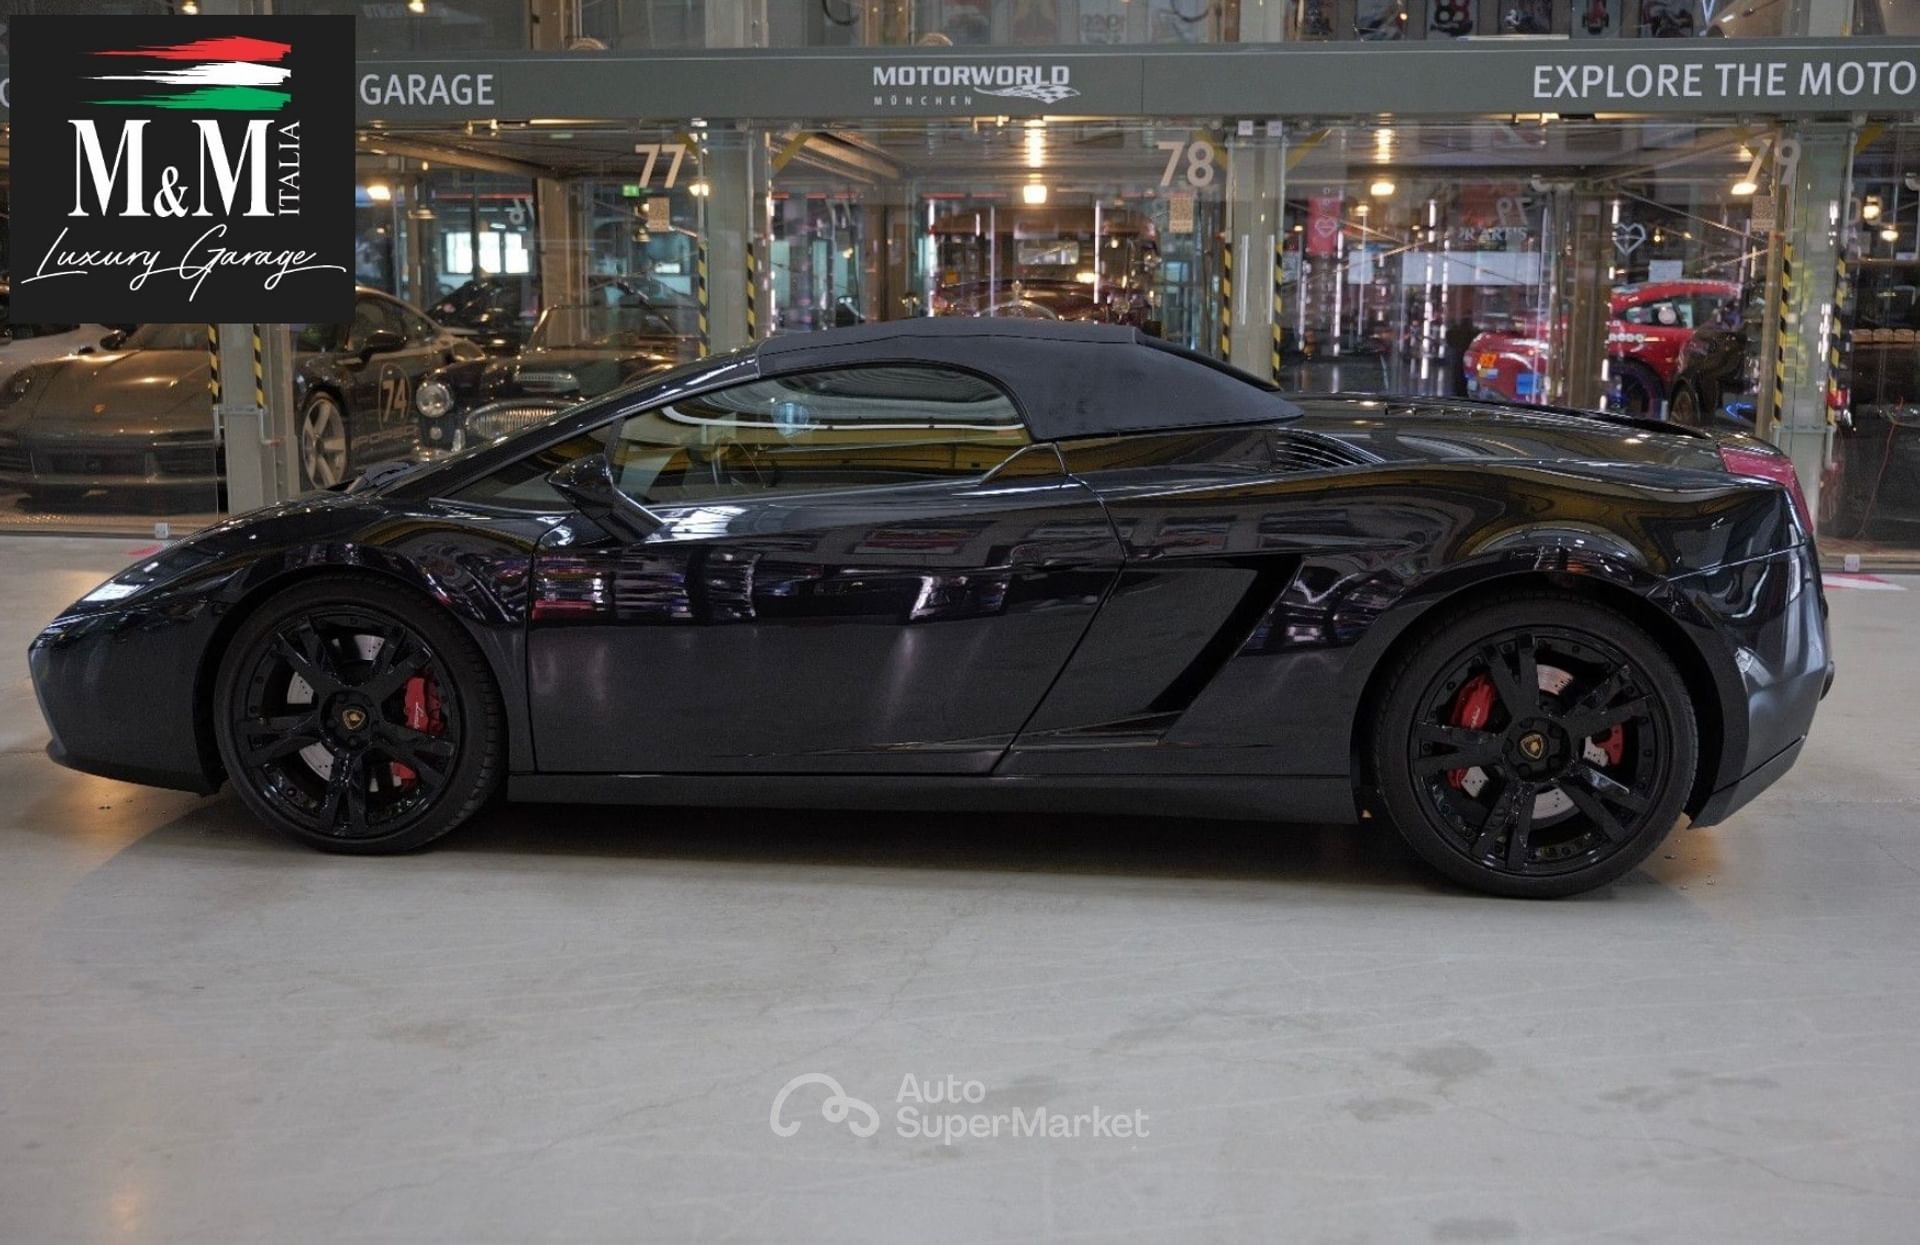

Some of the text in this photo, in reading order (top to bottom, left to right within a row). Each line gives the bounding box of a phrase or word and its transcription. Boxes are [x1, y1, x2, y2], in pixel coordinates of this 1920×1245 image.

[359, 74, 495, 105] GARAGE
[873, 66, 1070, 86] MOTORWORLD
[1533, 60, 1918, 98] EXPLORE THE MOTO
[874, 95, 972, 106] MÜNCHEN
[635, 143, 687, 189] 77
[1156, 141, 1214, 187] 78
[381, 376, 408, 422] 74
